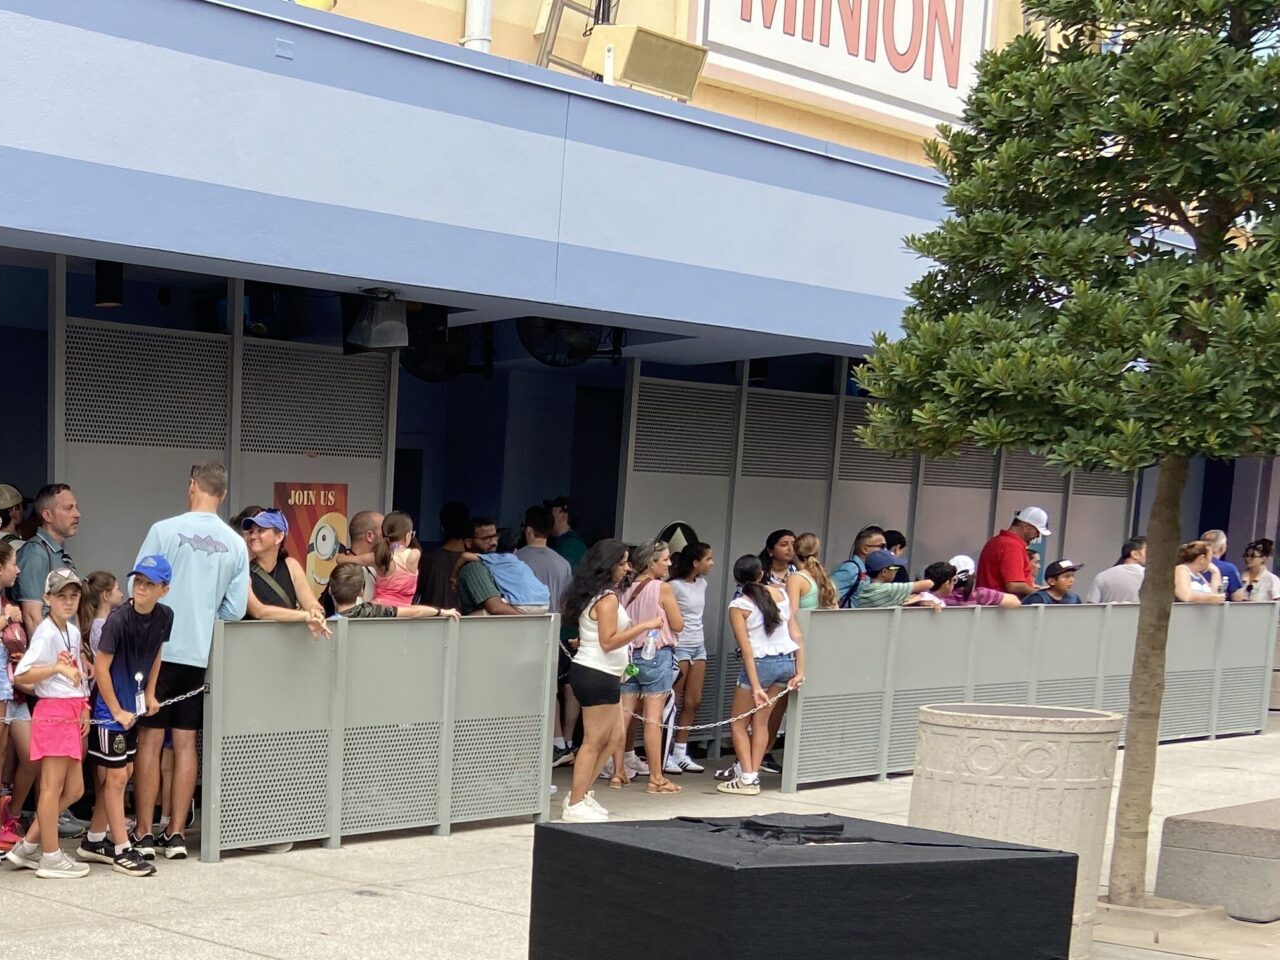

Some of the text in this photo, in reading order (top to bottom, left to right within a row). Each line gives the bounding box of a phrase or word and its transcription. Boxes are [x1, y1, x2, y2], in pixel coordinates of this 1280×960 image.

[740, 0, 965, 90] NION
[288, 490, 336, 506] JOIN US
